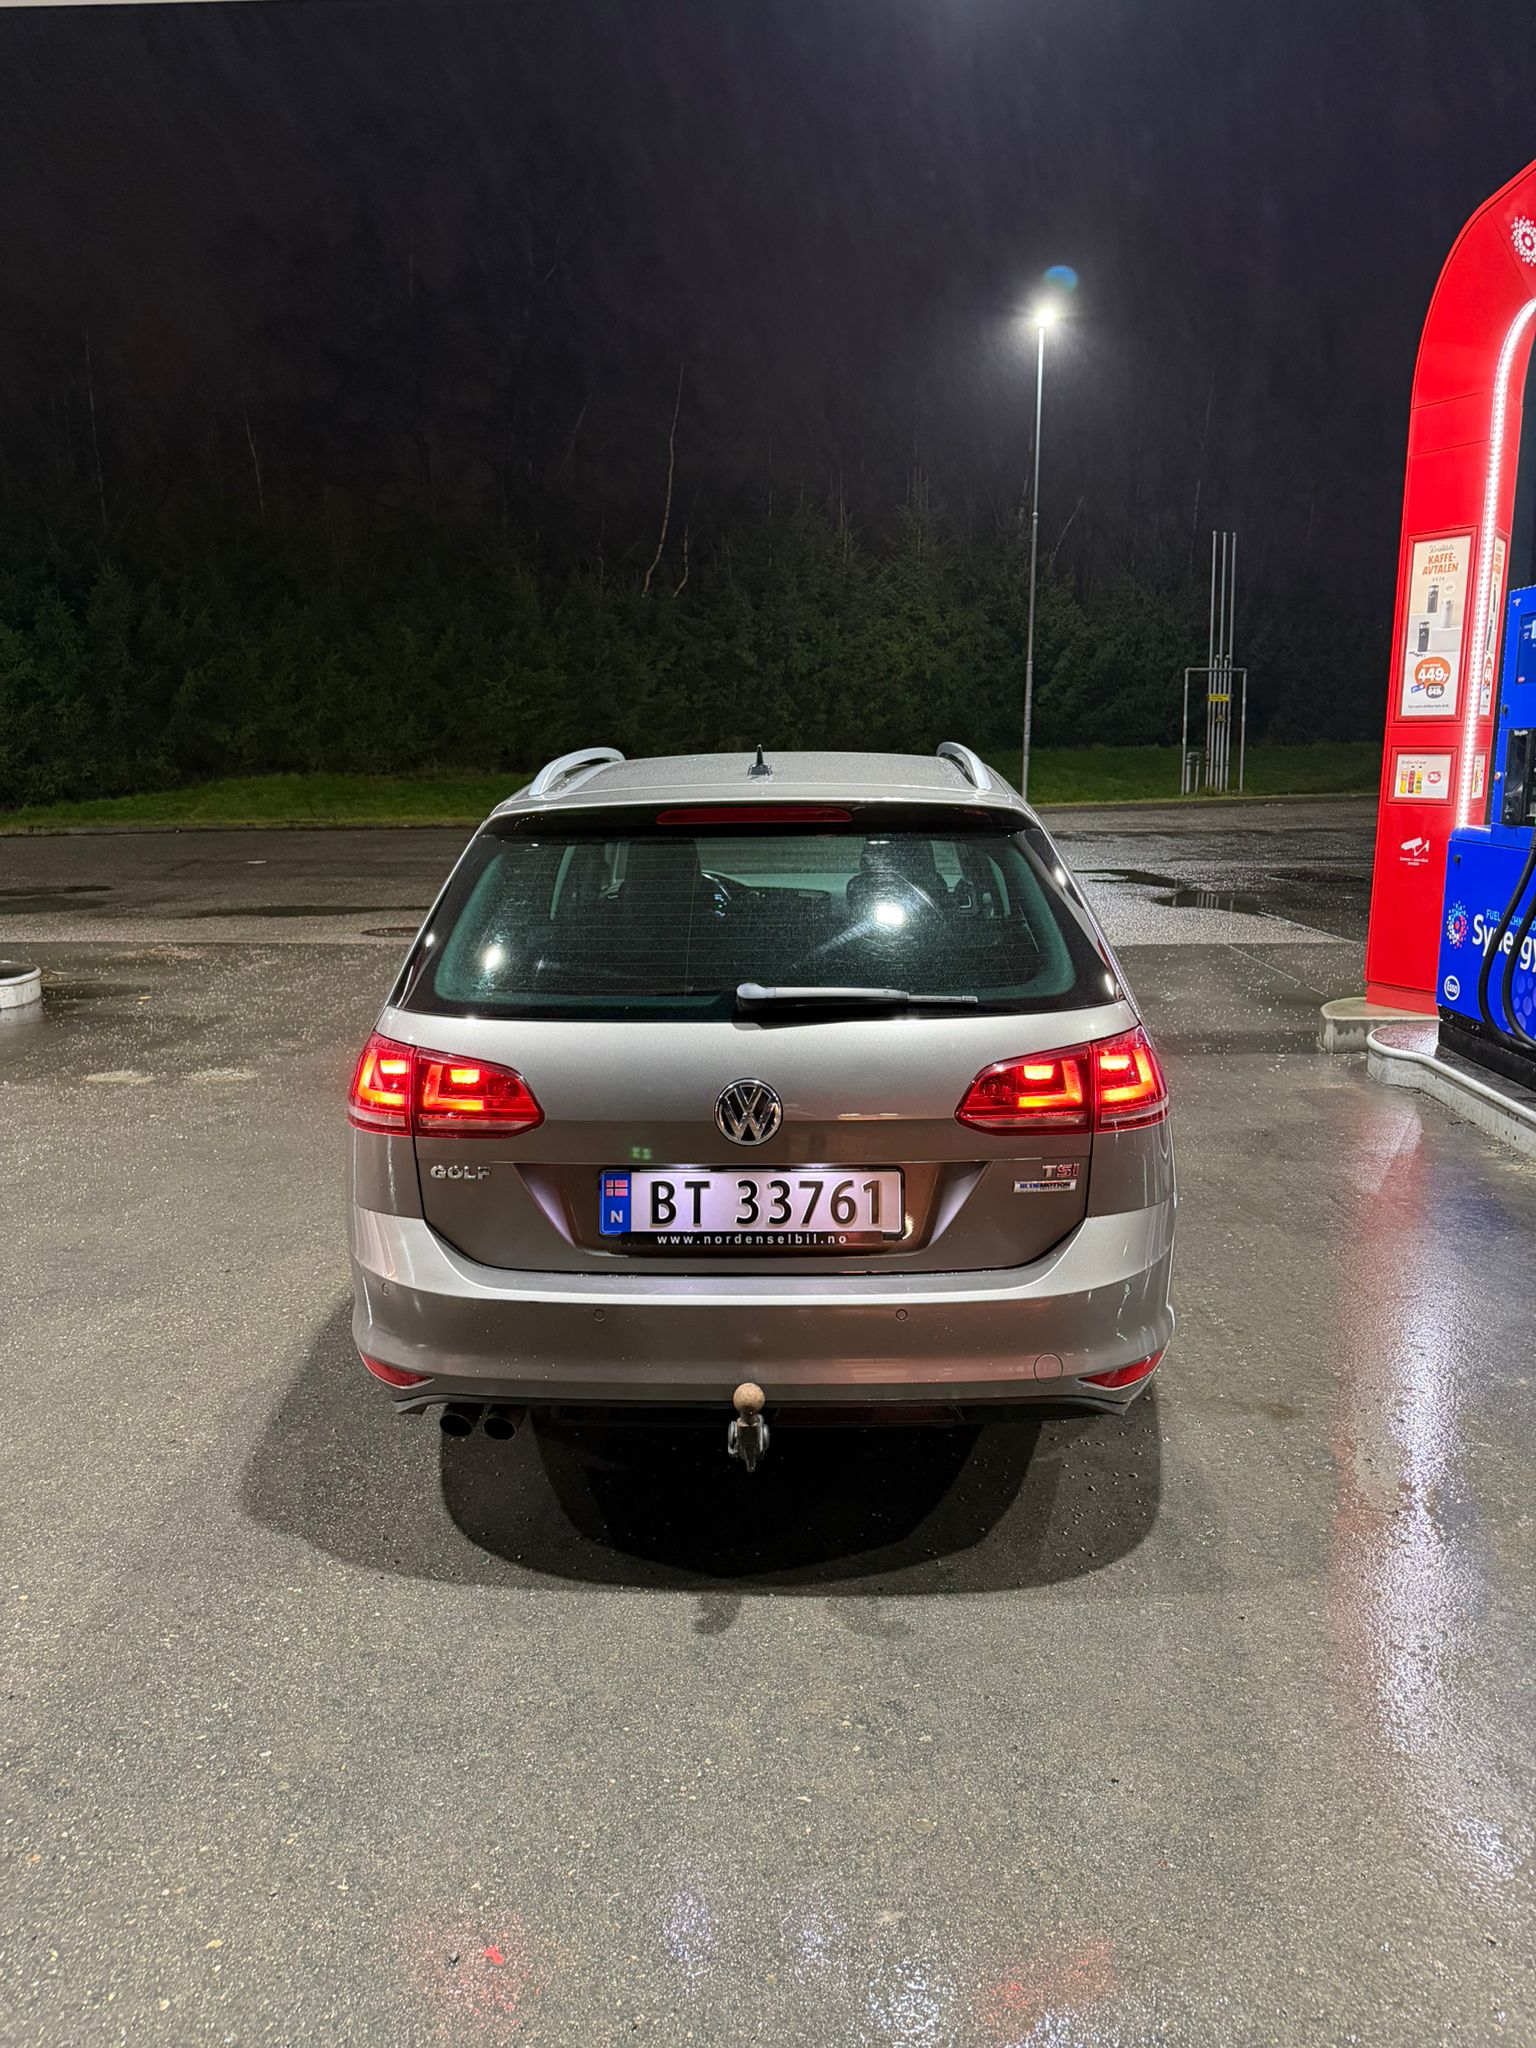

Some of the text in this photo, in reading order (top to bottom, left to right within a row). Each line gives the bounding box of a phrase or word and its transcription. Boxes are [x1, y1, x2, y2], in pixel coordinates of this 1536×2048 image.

[1428, 553, 1456, 564] KAFFE-
[1422, 562, 1459, 576] AVTALEN
[1486, 909, 1501, 922] FUEL
[430, 1165, 491, 1180] GOLF
[1042, 1164, 1080, 1178] TSI
[650, 1180, 881, 1226] BT 33761
[610, 1209, 623, 1223] N
[657, 1233, 847, 1245] www.nordenselbil.no
